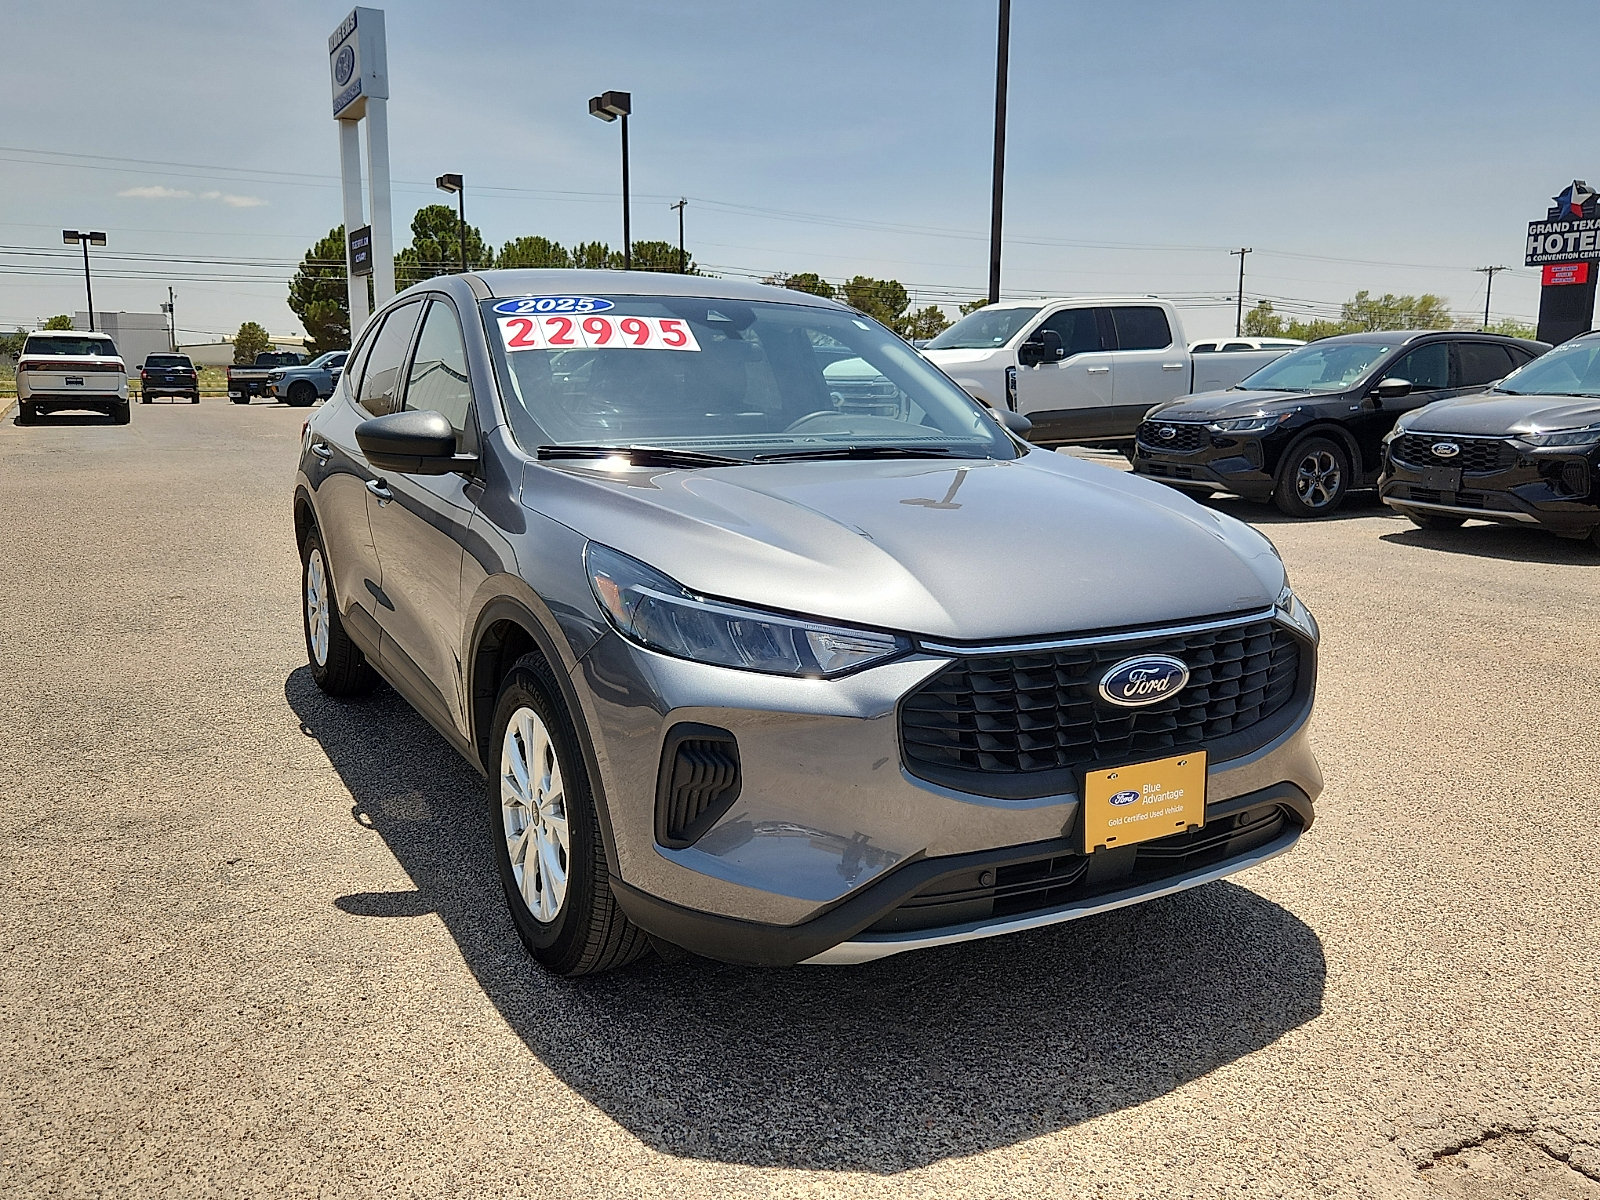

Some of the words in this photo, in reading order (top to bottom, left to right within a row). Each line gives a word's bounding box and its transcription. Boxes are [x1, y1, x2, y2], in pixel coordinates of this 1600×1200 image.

[1529, 222, 1570, 235] GRAND
[1533, 252, 1579, 262] CONVENTION
[514, 299, 595, 313] 2025
[505, 316, 689, 348] 22995
[1123, 667, 1178, 697] Ford
[1142, 783, 1161, 794] Blue
[1114, 792, 1135, 804] Ford
[1142, 788, 1184, 805] Advantage
[1108, 818, 1123, 827] Gold
[1123, 812, 1149, 824] Certified
[1149, 809, 1164, 818] Used
[1164, 805, 1184, 815] Vehicle
